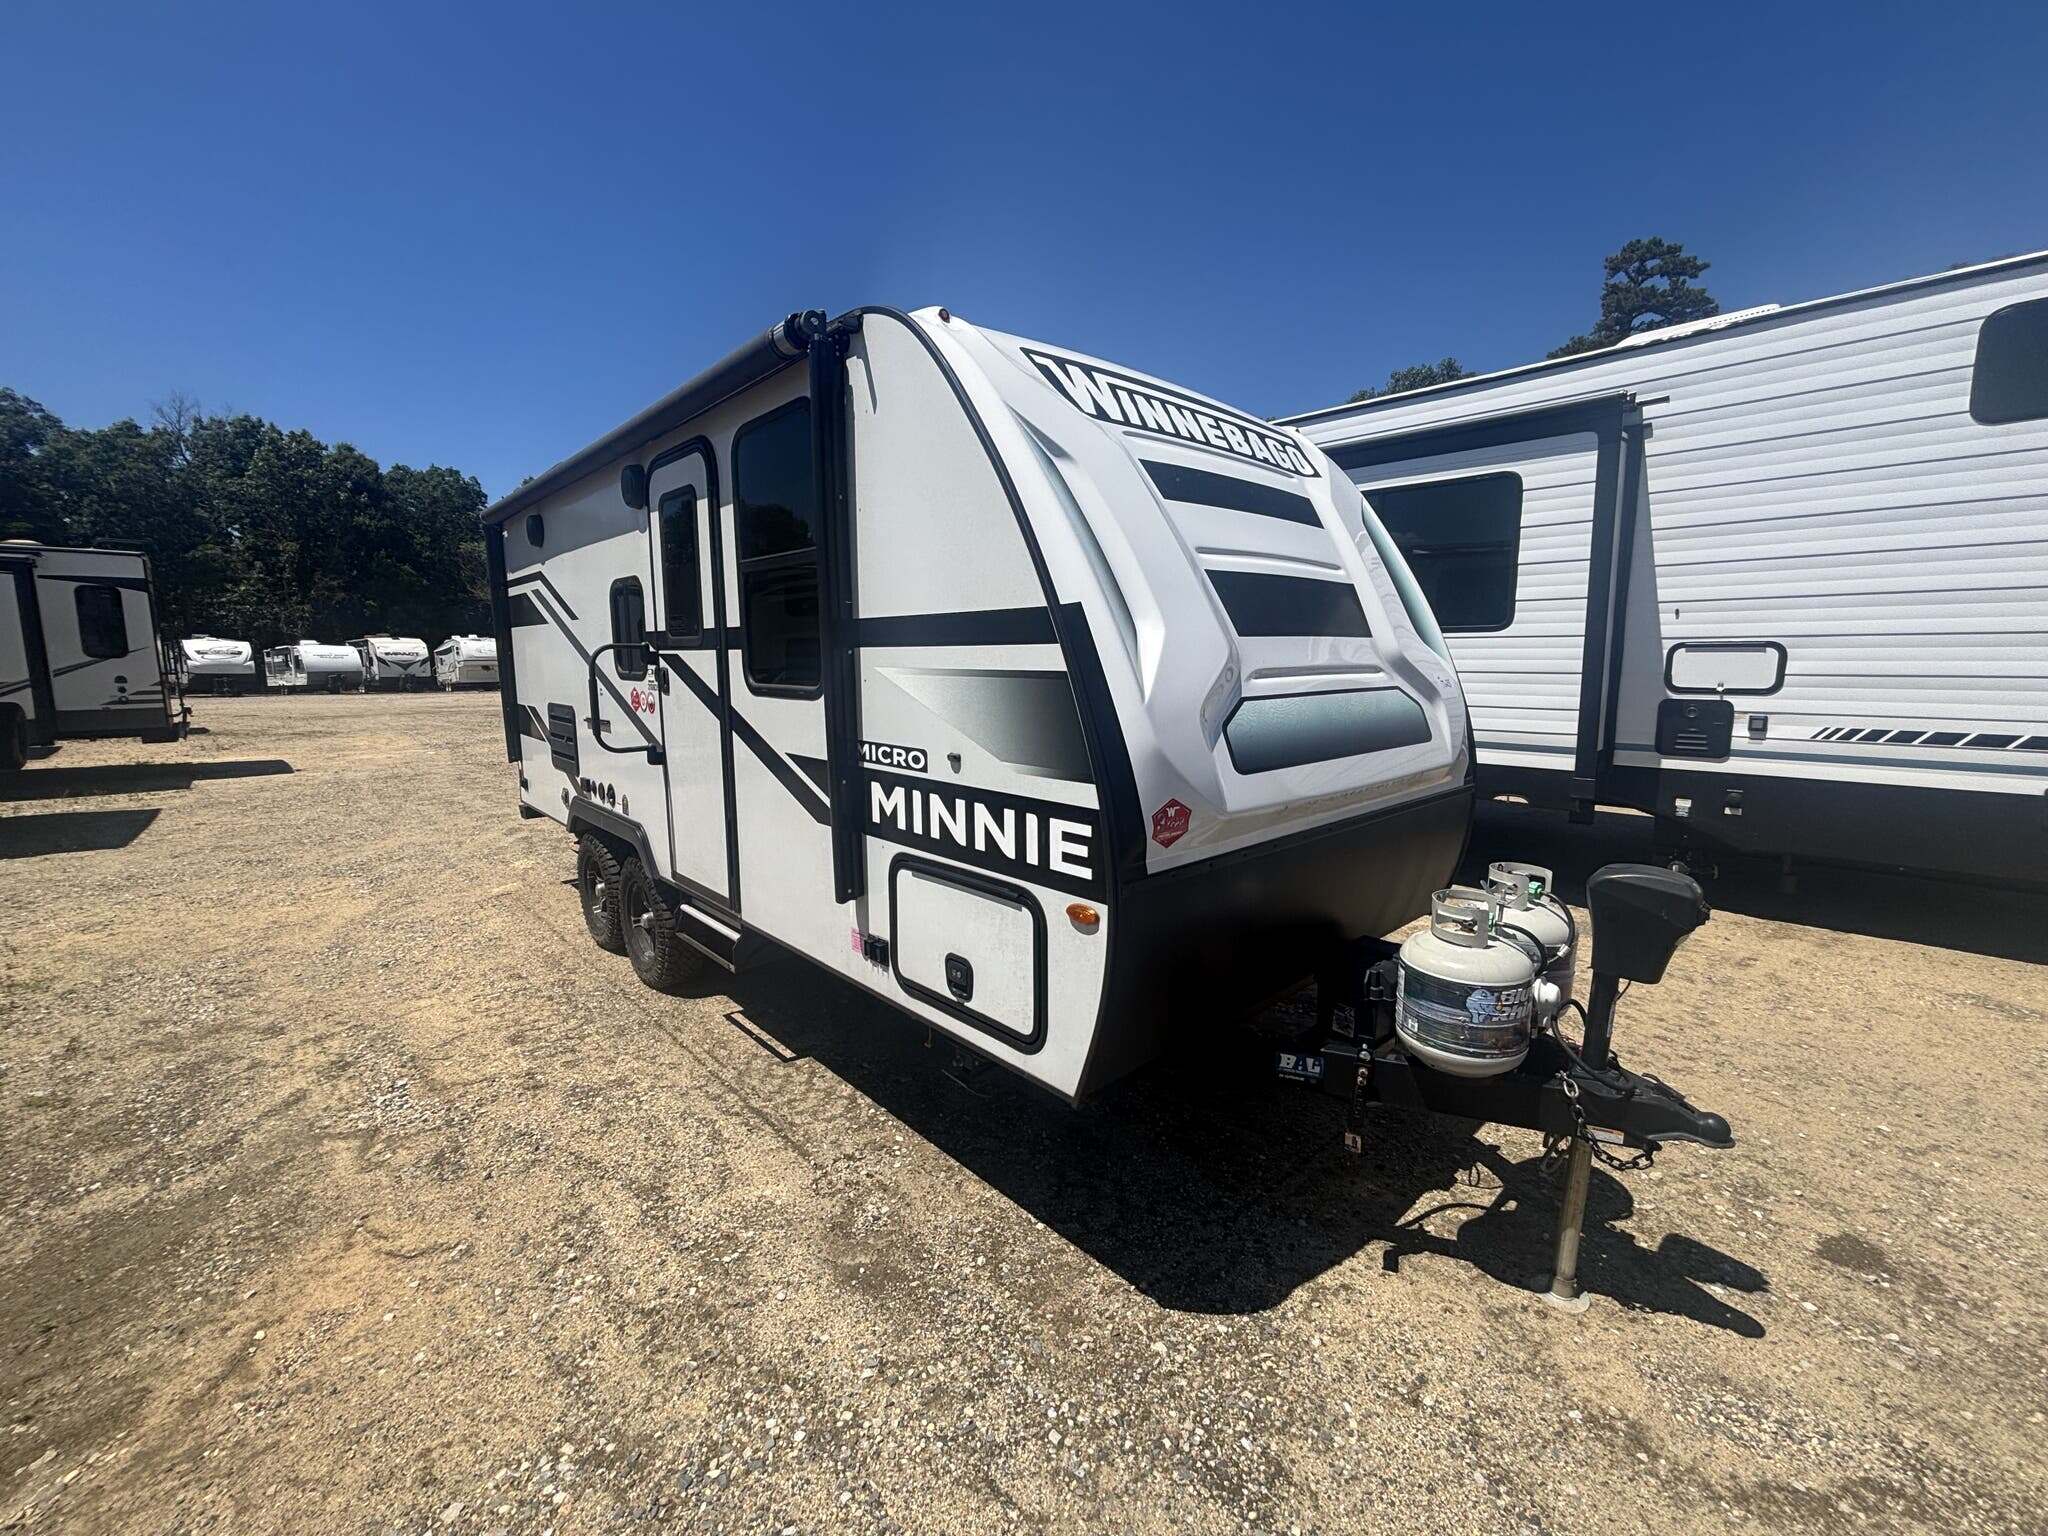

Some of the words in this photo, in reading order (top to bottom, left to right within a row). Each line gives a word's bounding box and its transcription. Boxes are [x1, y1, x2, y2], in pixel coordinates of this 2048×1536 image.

[1028, 351, 1313, 475] WINNEBAGO
[858, 743, 926, 769] MICRO
[871, 781, 1093, 881] MINNIE
